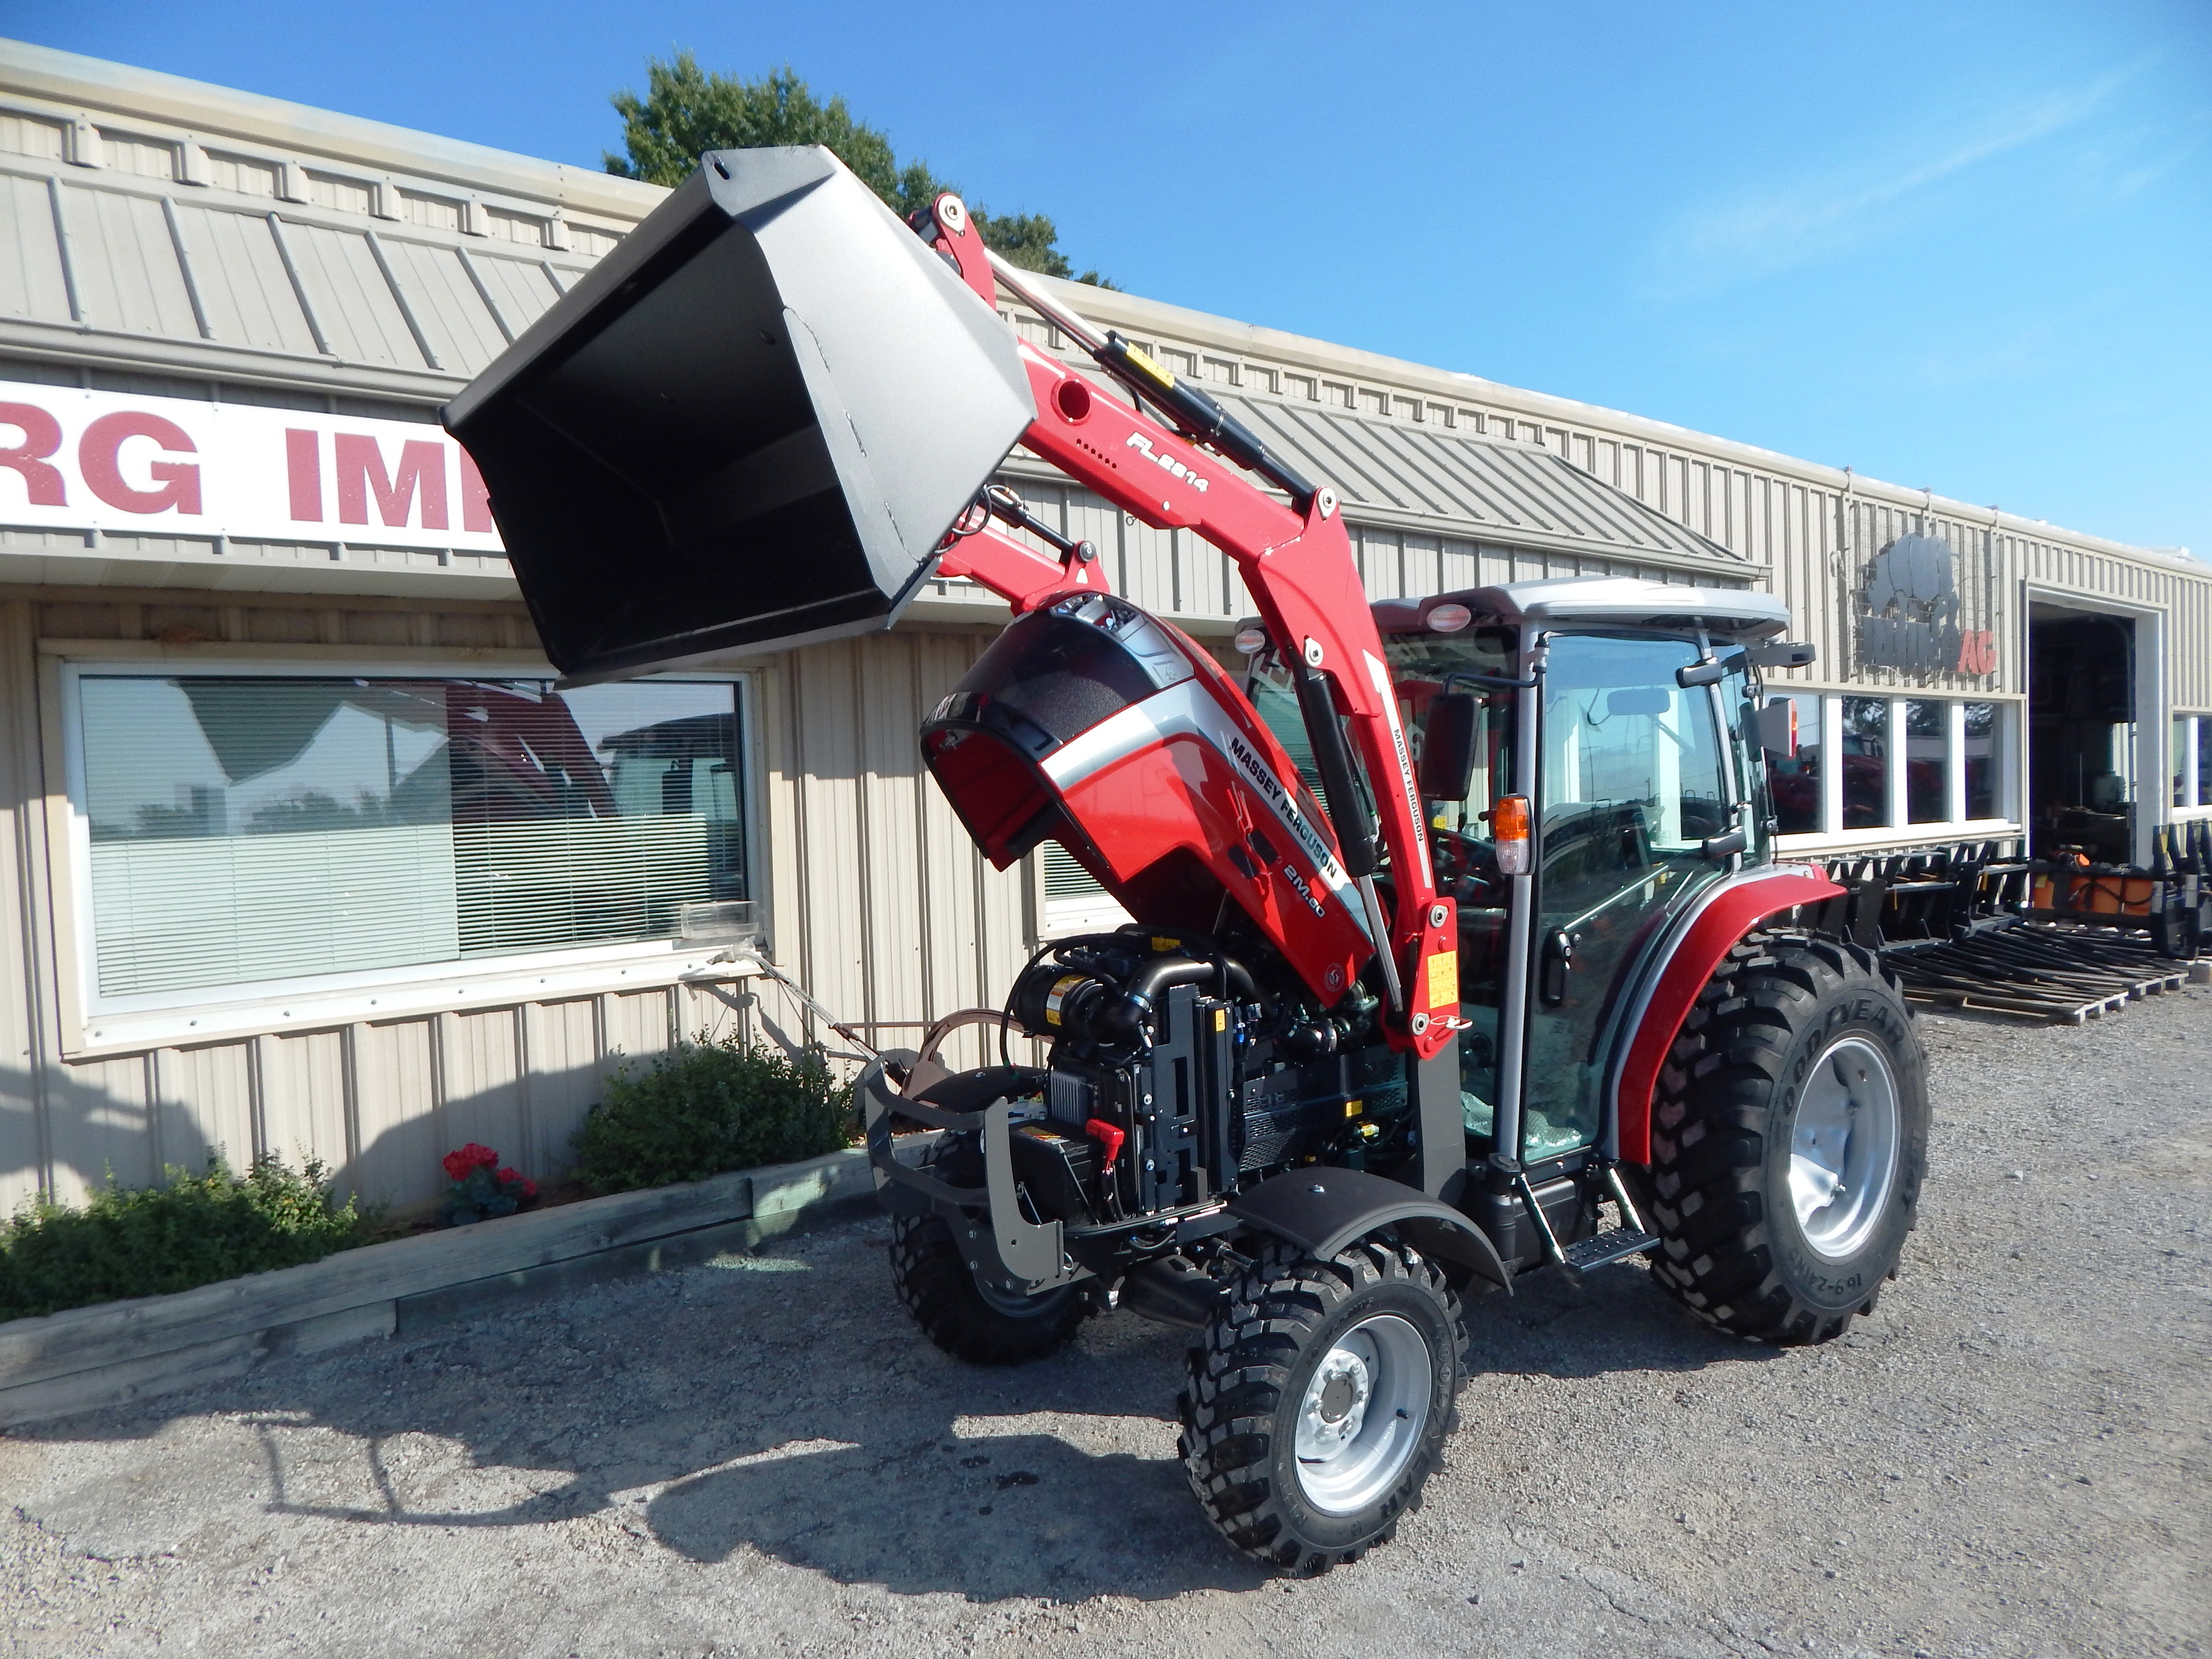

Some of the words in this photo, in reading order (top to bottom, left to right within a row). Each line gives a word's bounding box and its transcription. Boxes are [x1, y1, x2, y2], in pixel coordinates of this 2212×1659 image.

[1960, 629, 1996, 674] AG
[1230, 738, 1281, 799] MASSEY
[1281, 800, 1337, 878] FERGUSON
[1394, 729, 1410, 776] MASSEY
[1407, 780, 1424, 842] FERGUSON
[1284, 865, 1325, 917] 2M.60
